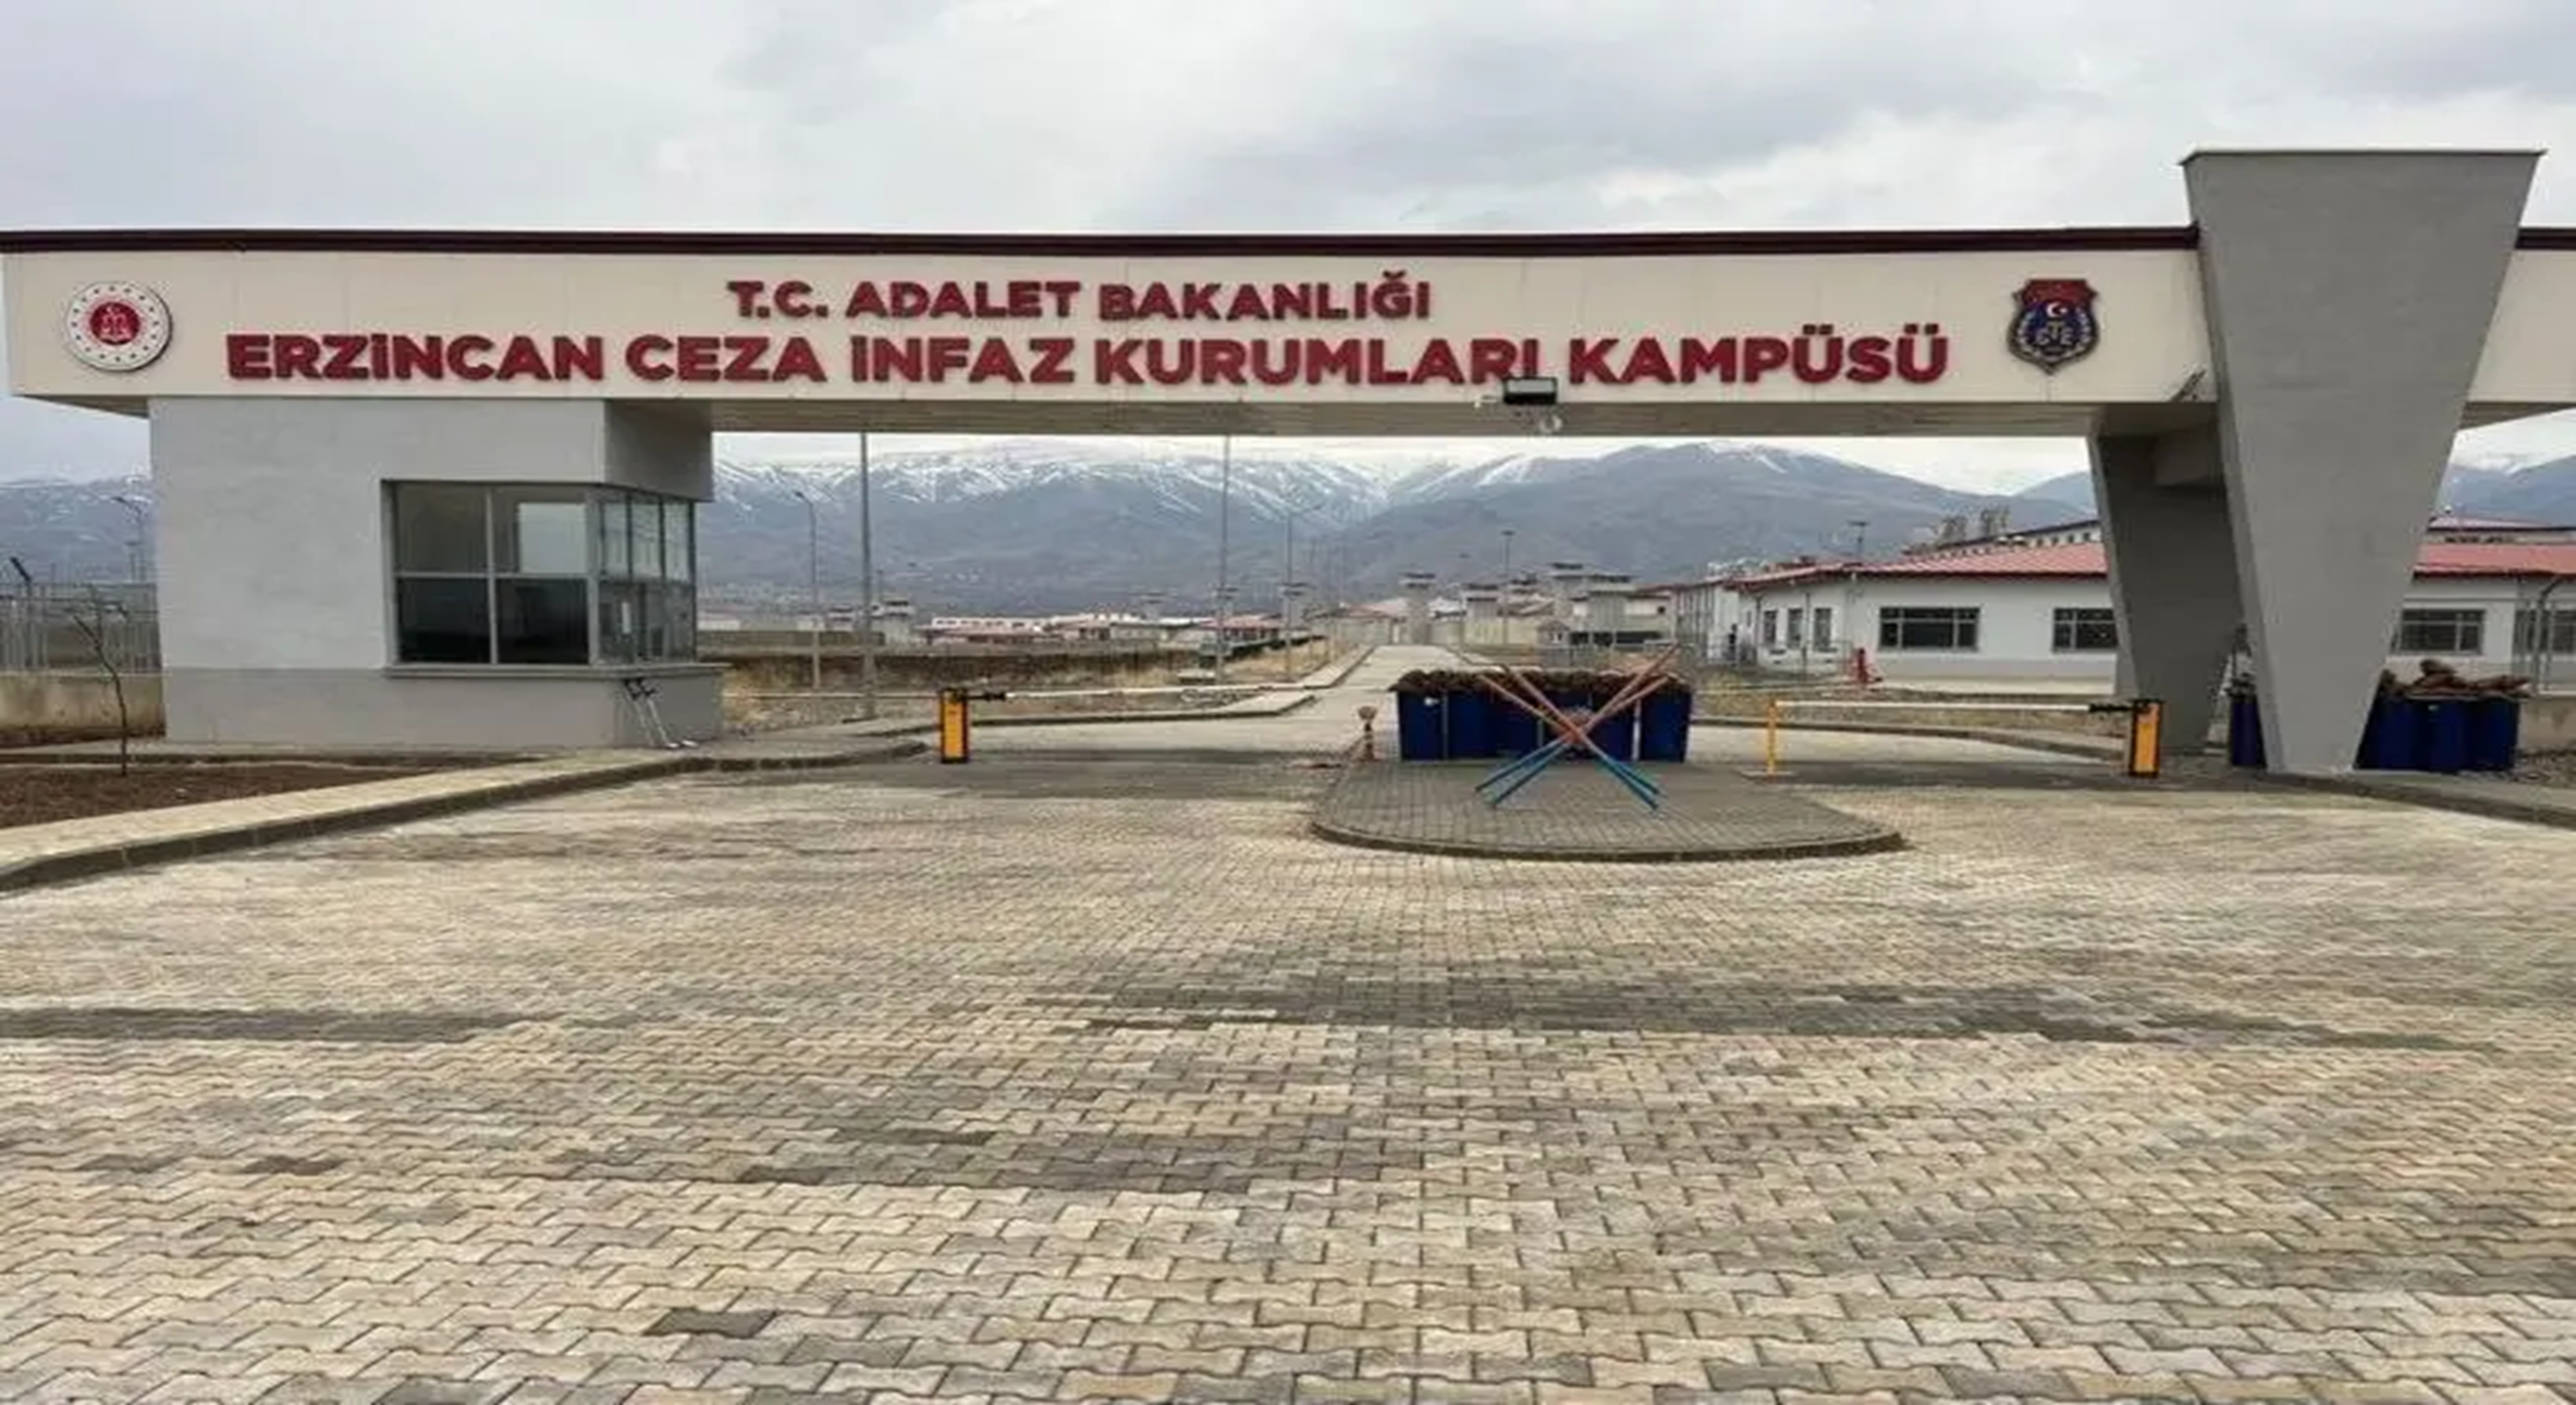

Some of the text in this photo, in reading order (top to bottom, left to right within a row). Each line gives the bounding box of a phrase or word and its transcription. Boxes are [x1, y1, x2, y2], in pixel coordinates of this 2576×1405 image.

[728, 271, 1431, 320] T.C. ADALET BAKANLIĞI
[626, 335, 826, 382] CEZA
[1096, 337, 1540, 384] KURUMLARI
[1569, 324, 1949, 384] KAMPÜSÜ
